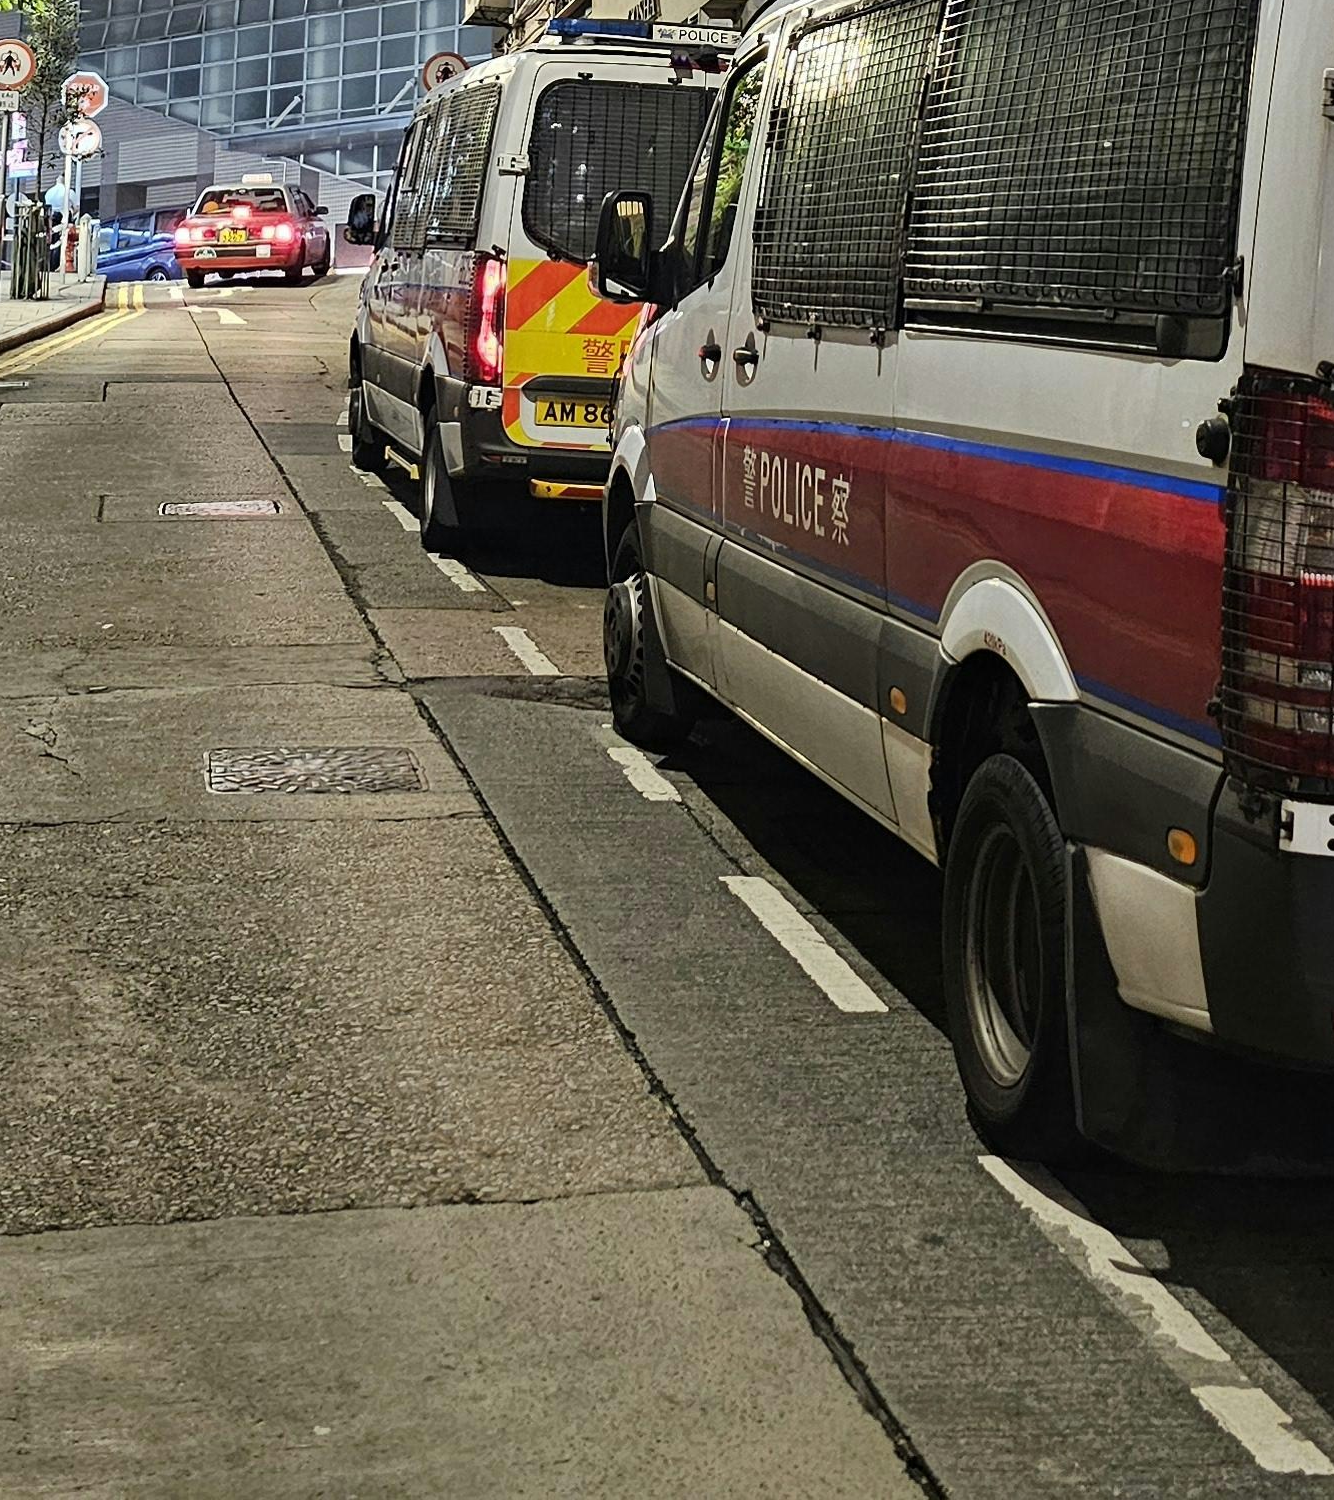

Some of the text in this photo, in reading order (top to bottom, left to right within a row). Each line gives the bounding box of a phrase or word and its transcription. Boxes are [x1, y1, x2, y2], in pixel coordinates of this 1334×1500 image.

[679, 30, 728, 45] POLICE
[582, 339, 616, 373] 警
[543, 402, 576, 422] AM
[743, 444, 850, 546] 警 POLICE 察
